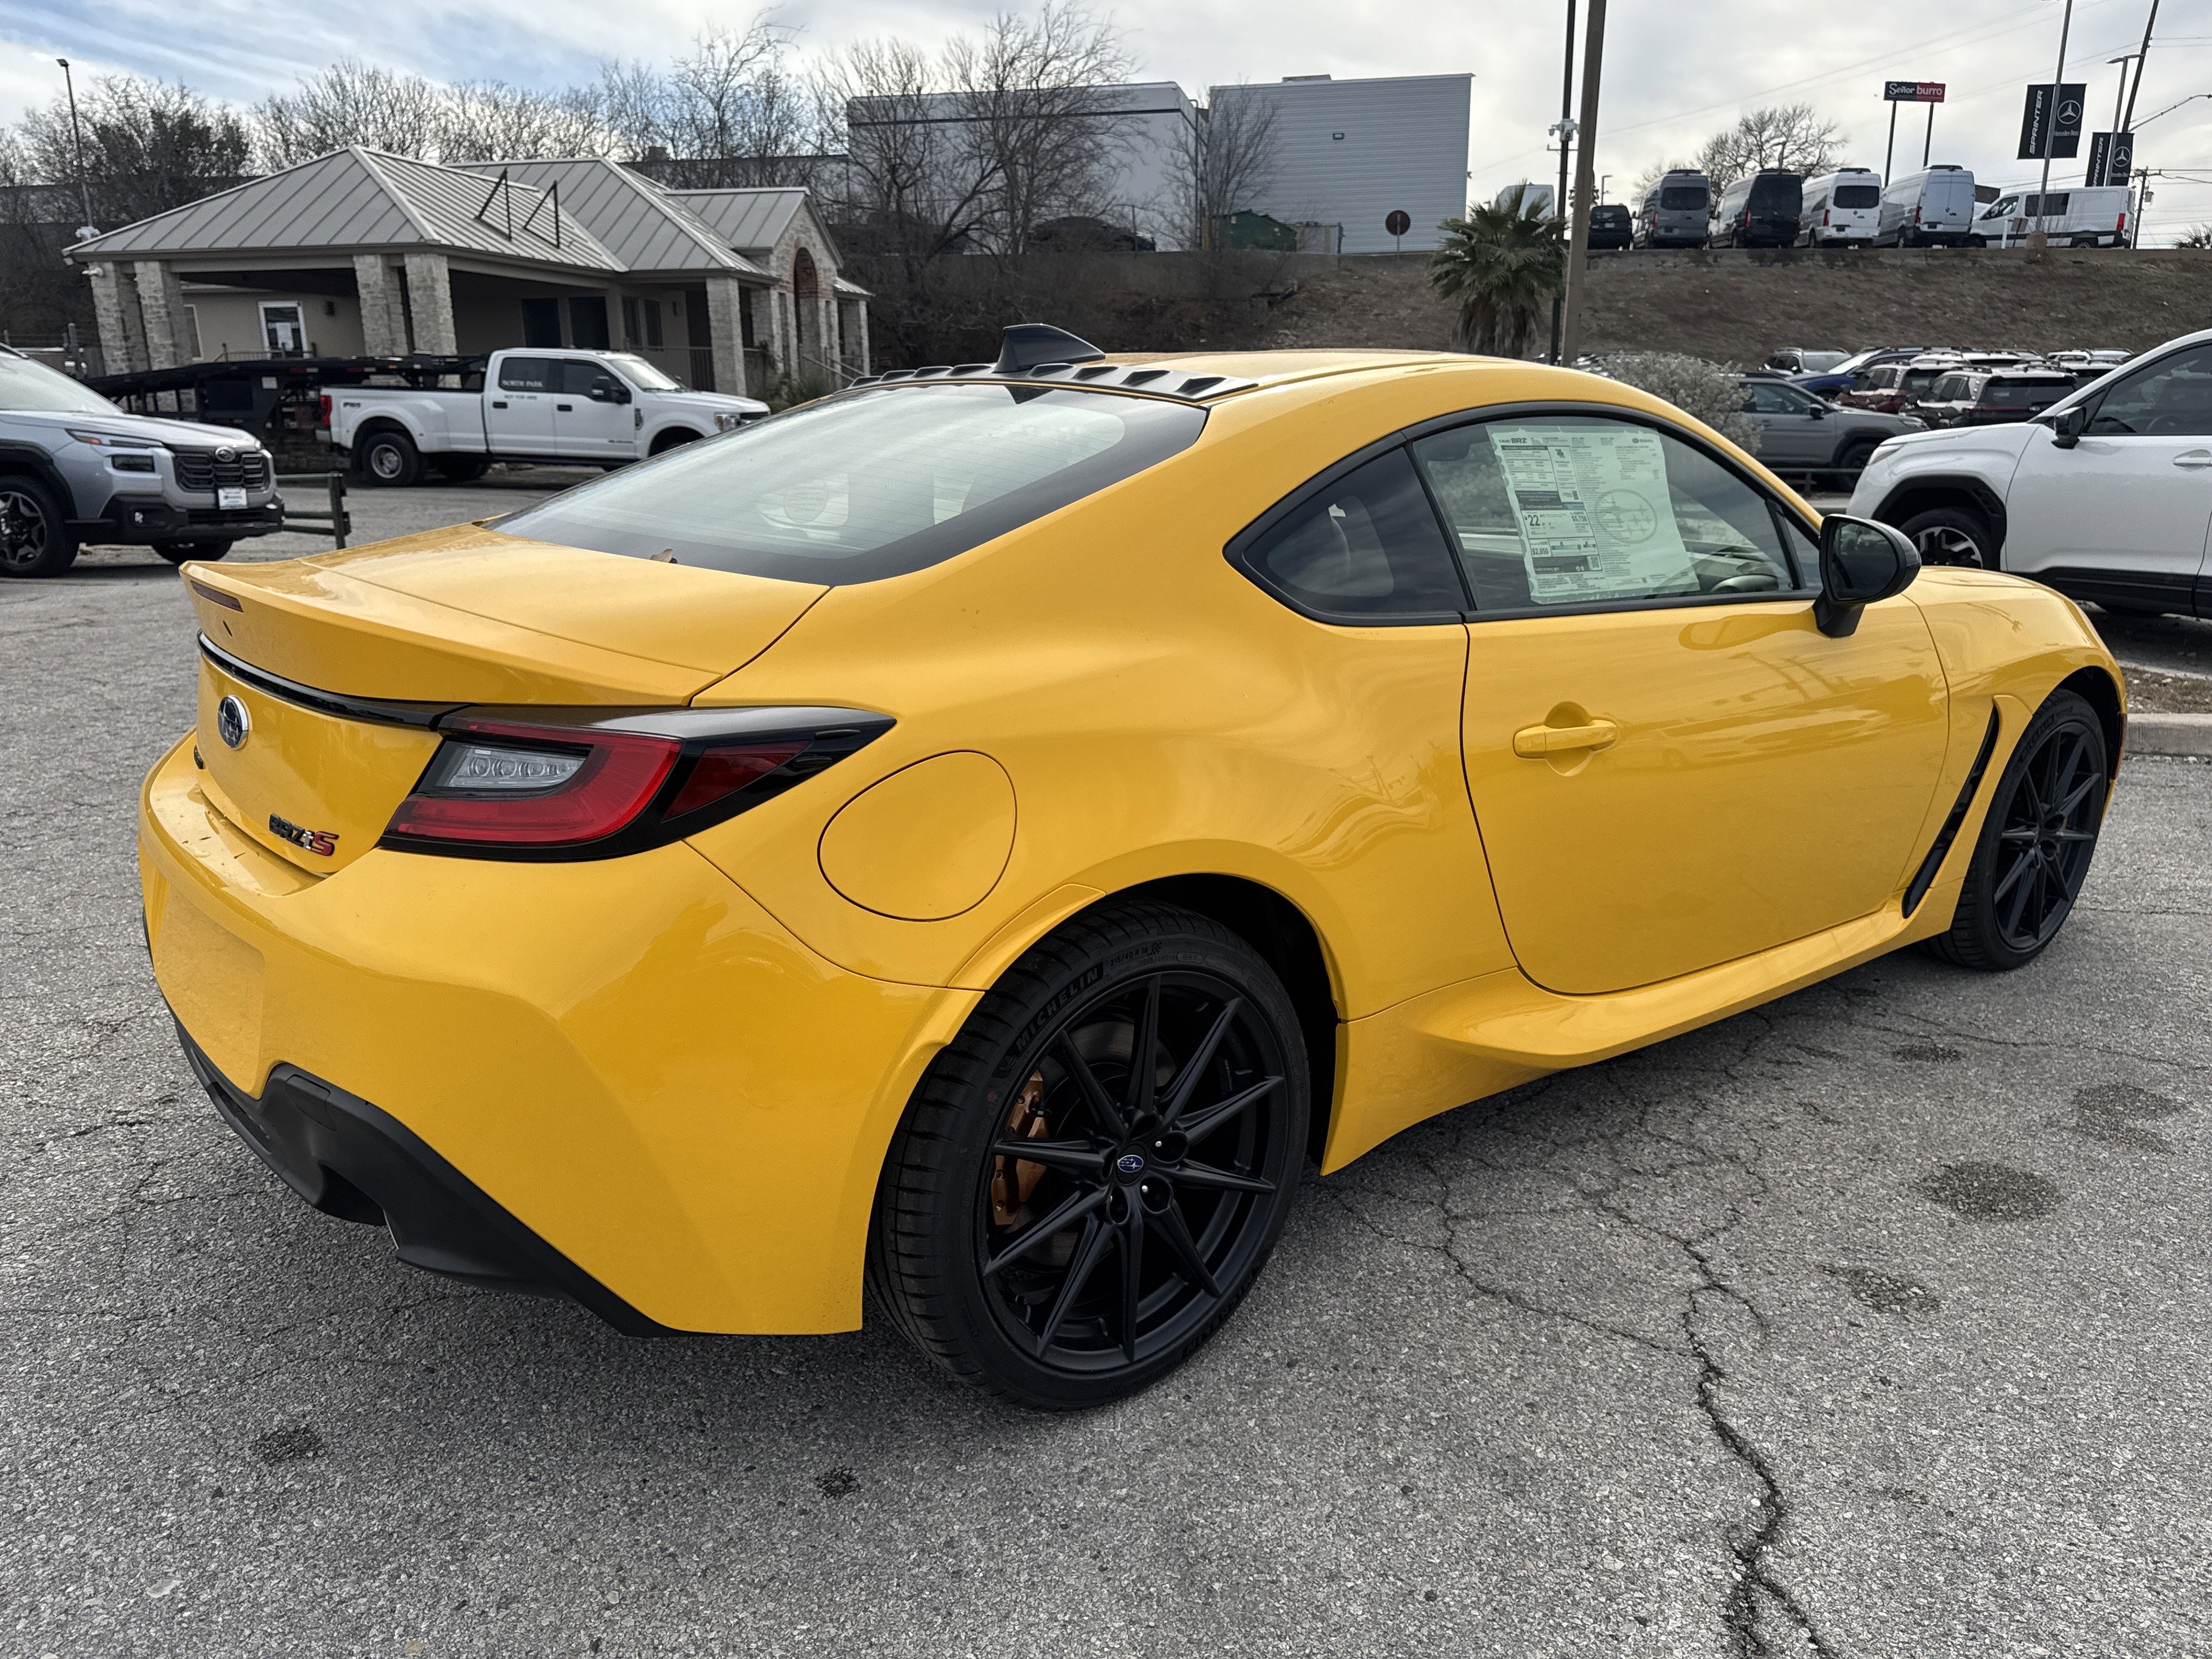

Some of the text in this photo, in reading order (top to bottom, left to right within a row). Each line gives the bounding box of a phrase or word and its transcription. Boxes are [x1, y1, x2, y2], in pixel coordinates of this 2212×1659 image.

[1889, 83, 1943, 95] Señor burro
[2029, 89, 2044, 155] SPRINTER
[2092, 137, 2104, 187] PRINTER
[1527, 514, 1541, 527] 22
[1109, 951, 1133, 967] 215/40
[1015, 967, 1098, 1053] MICHELIN
